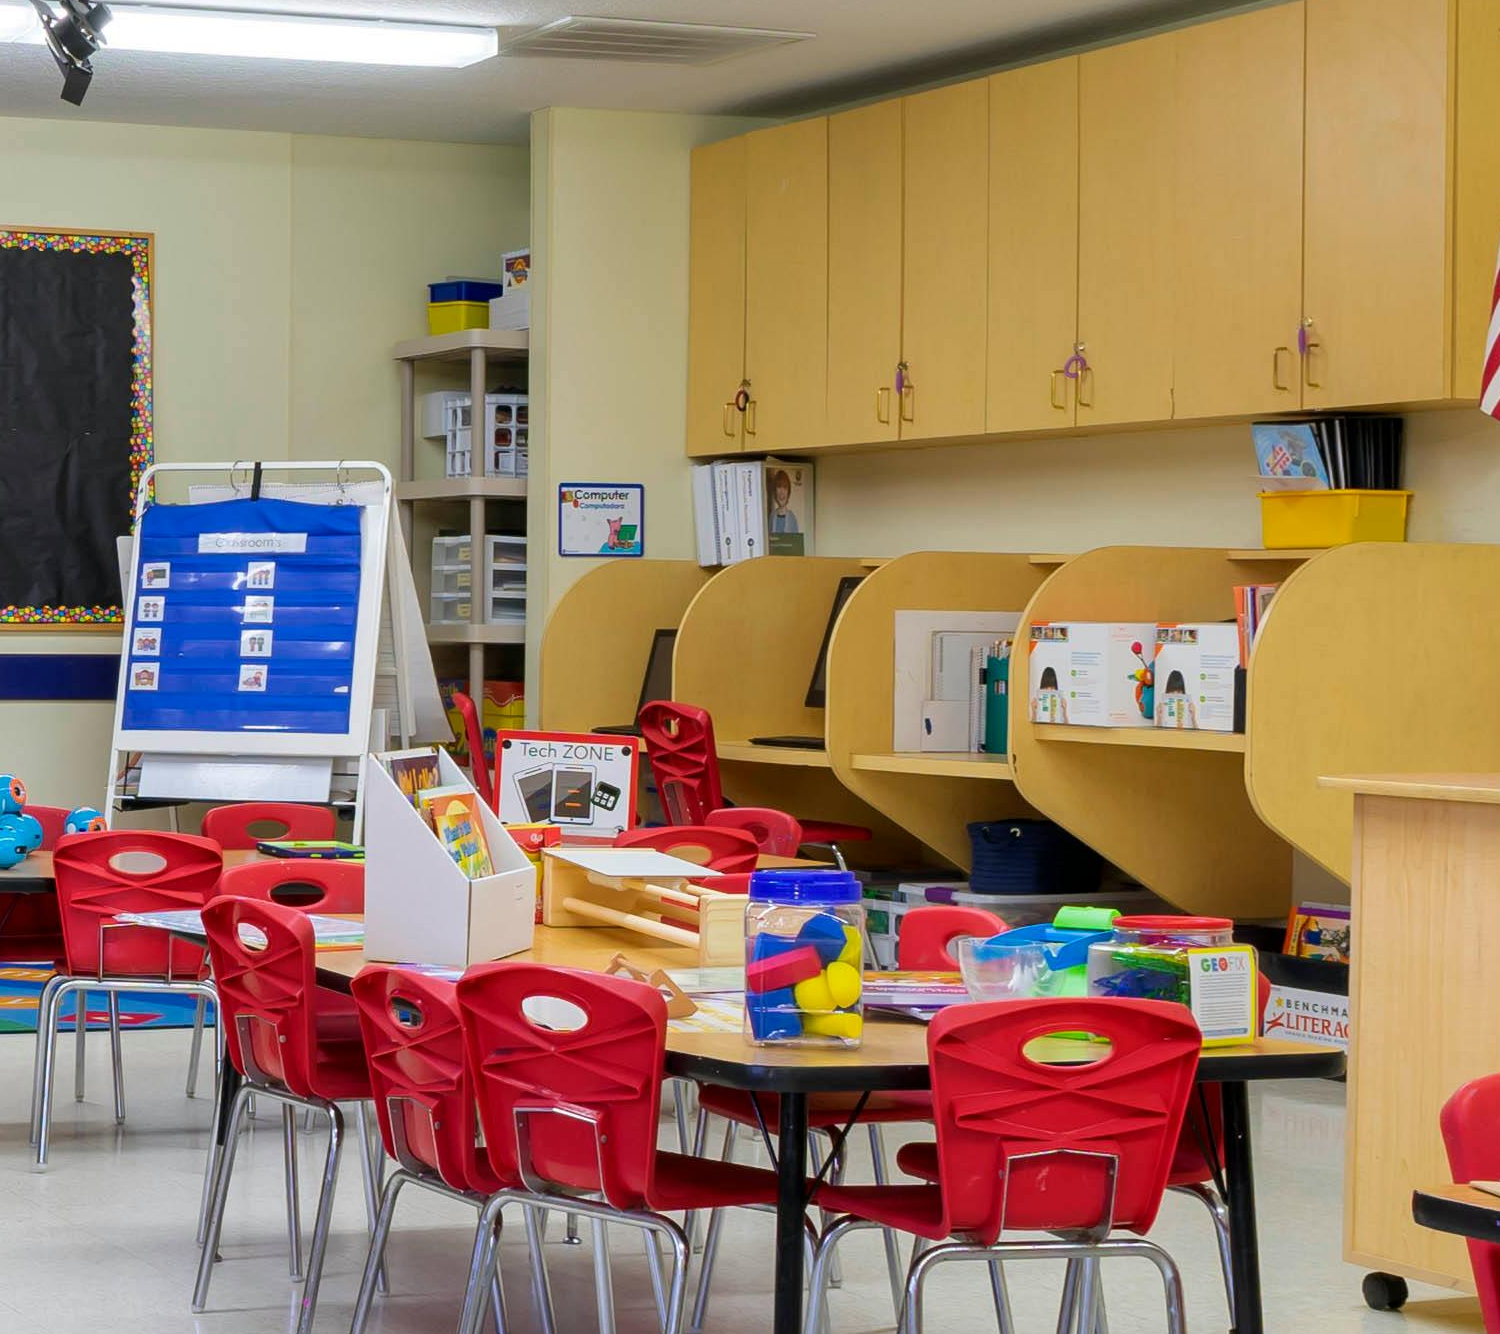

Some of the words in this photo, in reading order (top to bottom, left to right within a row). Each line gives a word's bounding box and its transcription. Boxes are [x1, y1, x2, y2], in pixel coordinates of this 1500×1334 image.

[574, 489, 629, 502] Computer
[520, 742, 556, 757] Tech
[563, 744, 614, 761] ZONE
[1201, 956, 1245, 972] GEOFIX
